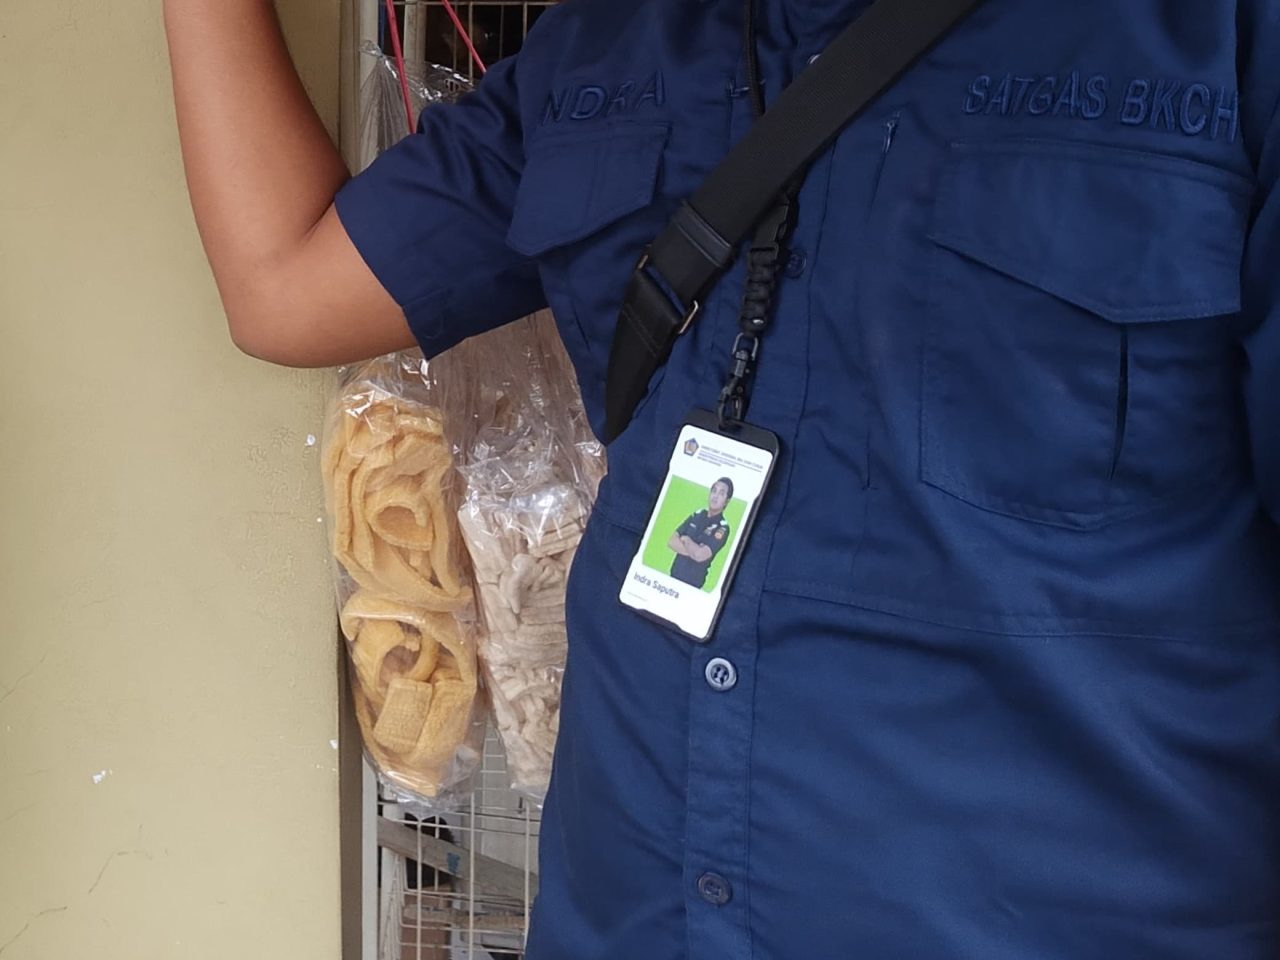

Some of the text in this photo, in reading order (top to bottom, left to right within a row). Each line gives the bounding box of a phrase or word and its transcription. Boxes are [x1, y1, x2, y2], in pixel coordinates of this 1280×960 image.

[963, 69, 1239, 144] SATGAS BKCH
[633, 571, 652, 587] Indra
[652, 580, 680, 599] Saputra
